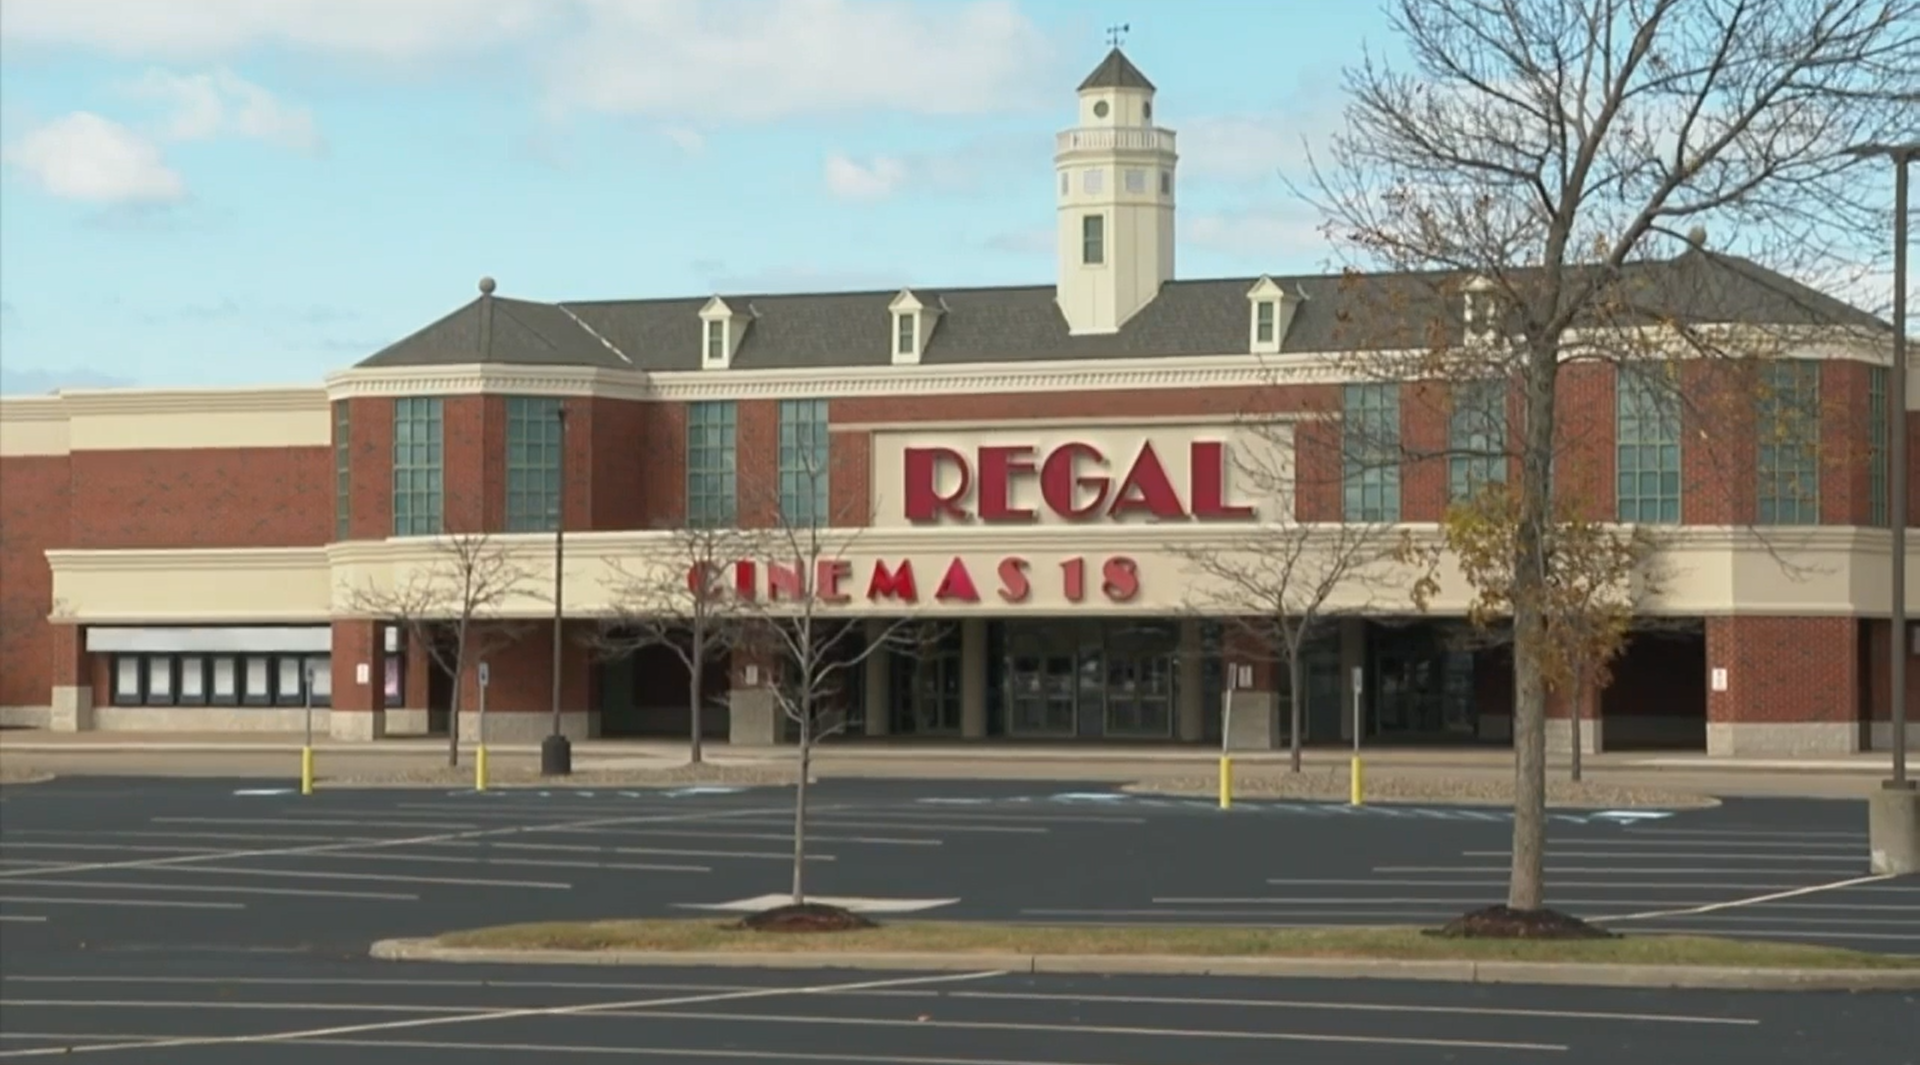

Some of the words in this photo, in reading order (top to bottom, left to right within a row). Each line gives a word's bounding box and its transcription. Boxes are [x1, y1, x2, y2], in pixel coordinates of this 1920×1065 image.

[904, 440, 1254, 520] REGAL
[686, 556, 1033, 603] CINEMAS
[1060, 556, 1140, 602] 18
